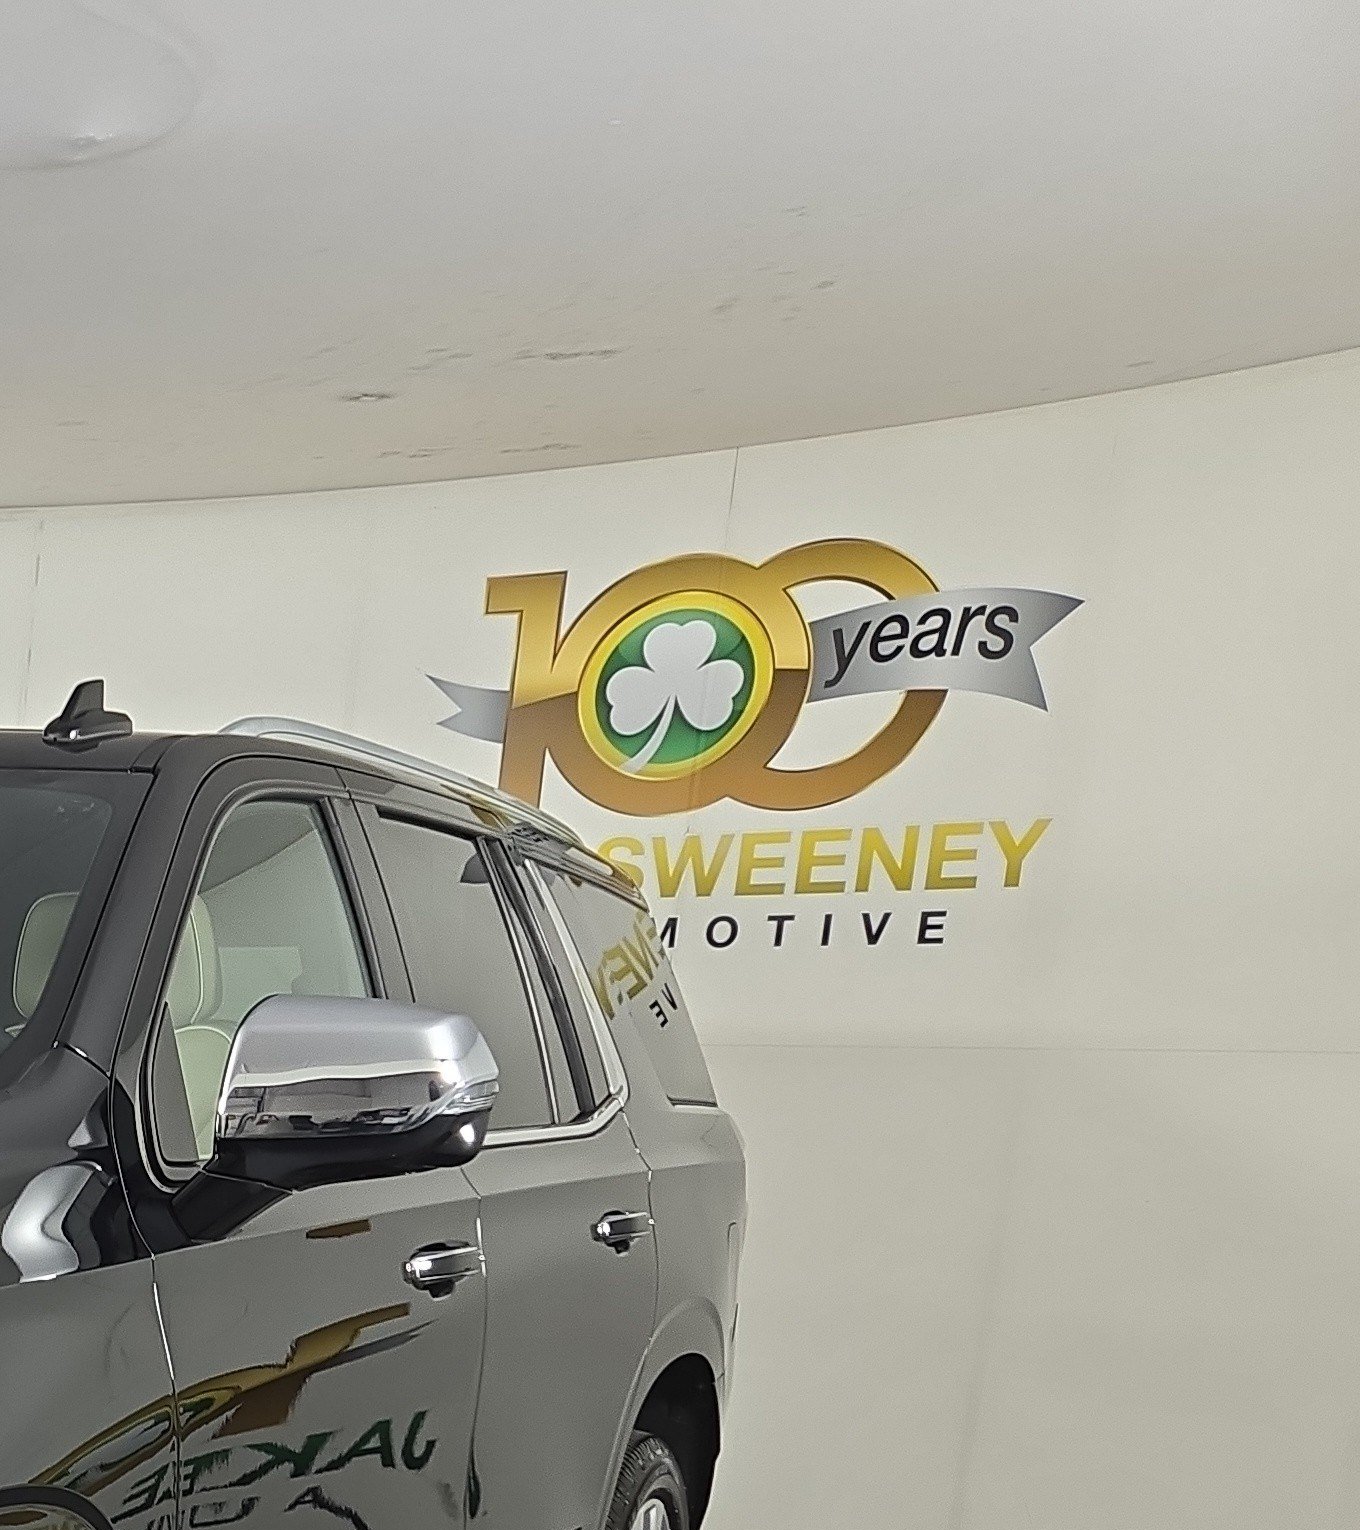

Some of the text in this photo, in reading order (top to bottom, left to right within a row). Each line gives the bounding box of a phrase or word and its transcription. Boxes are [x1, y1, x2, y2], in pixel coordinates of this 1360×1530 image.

[485, 537, 948, 818] 100
[823, 601, 1019, 687] years
[598, 818, 1052, 897] SWEENEY
[651, 910, 948, 950] MOTIVE
